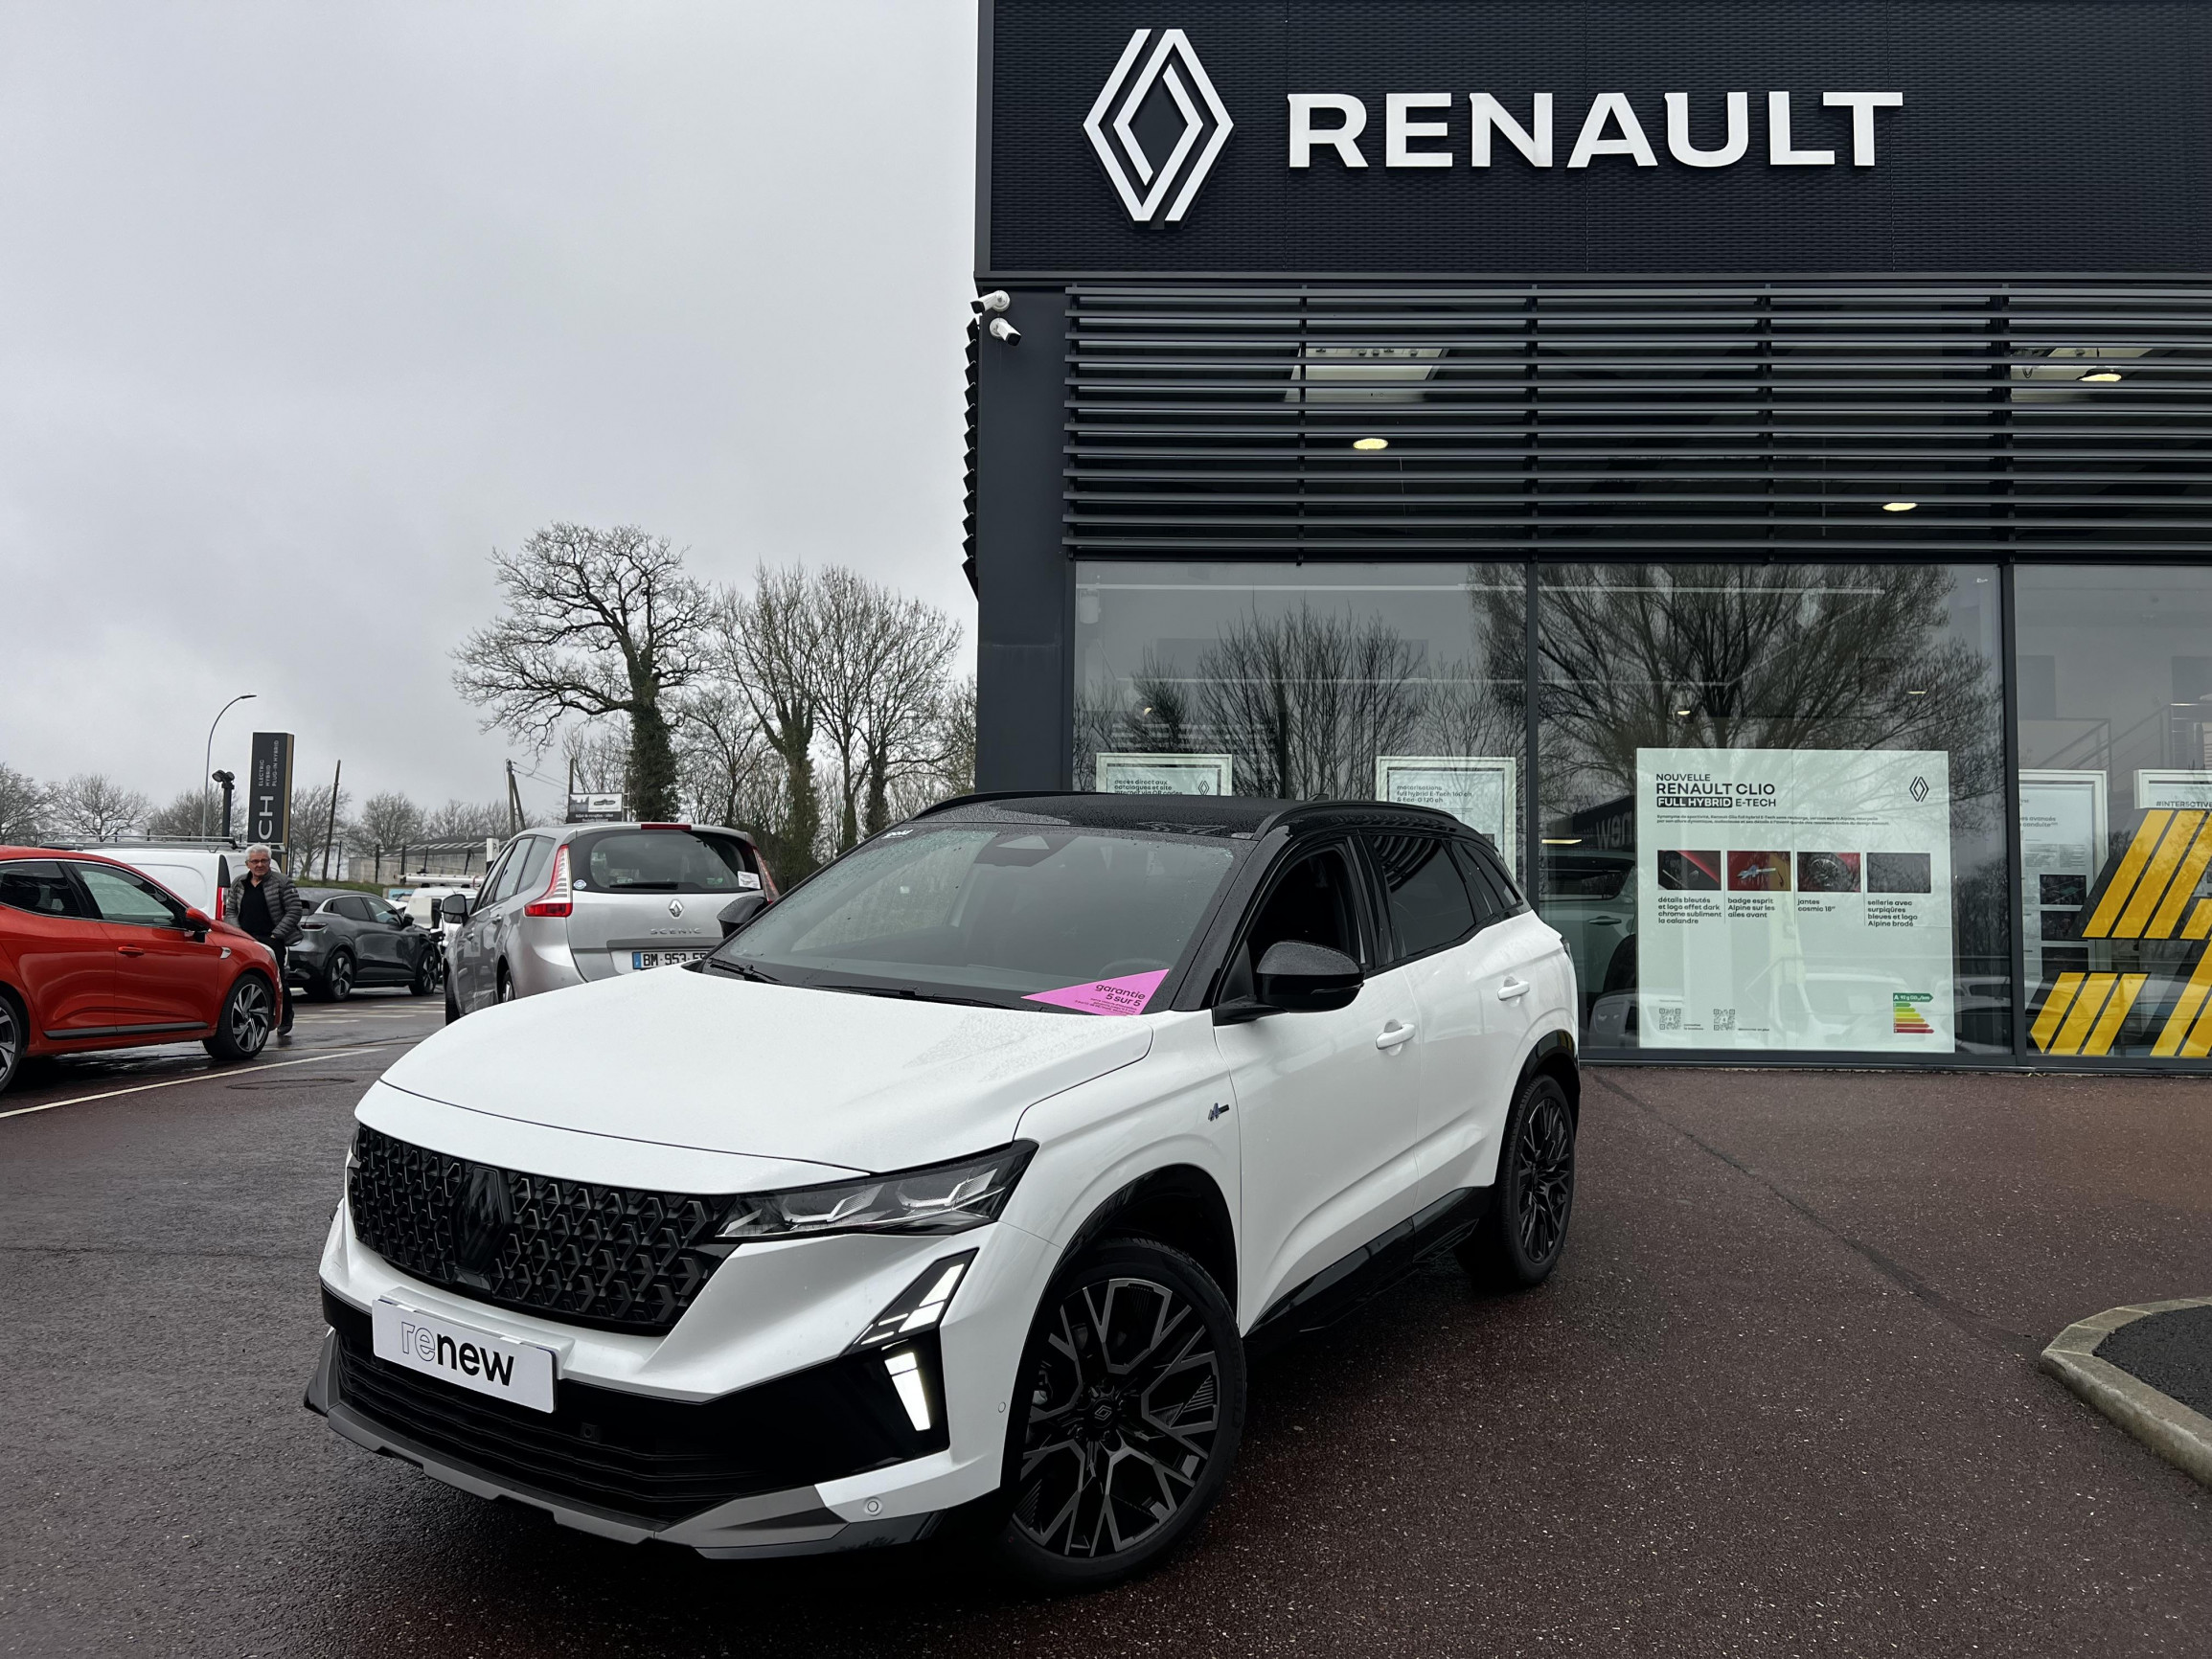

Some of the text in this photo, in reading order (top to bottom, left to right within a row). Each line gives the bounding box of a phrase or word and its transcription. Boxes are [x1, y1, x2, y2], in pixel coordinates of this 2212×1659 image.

[1287, 90, 1904, 169] RENAULT
[1656, 773, 1710, 782] NOUVELLE
[1656, 783, 1776, 795] RENAULT CLIO
[1658, 797, 1777, 807] FULL HYBRID E-TECH
[258, 795, 274, 843] CH
[1095, 984, 1146, 1000] garantie
[1115, 995, 1134, 1005] sur
[401, 1321, 514, 1386] renew
